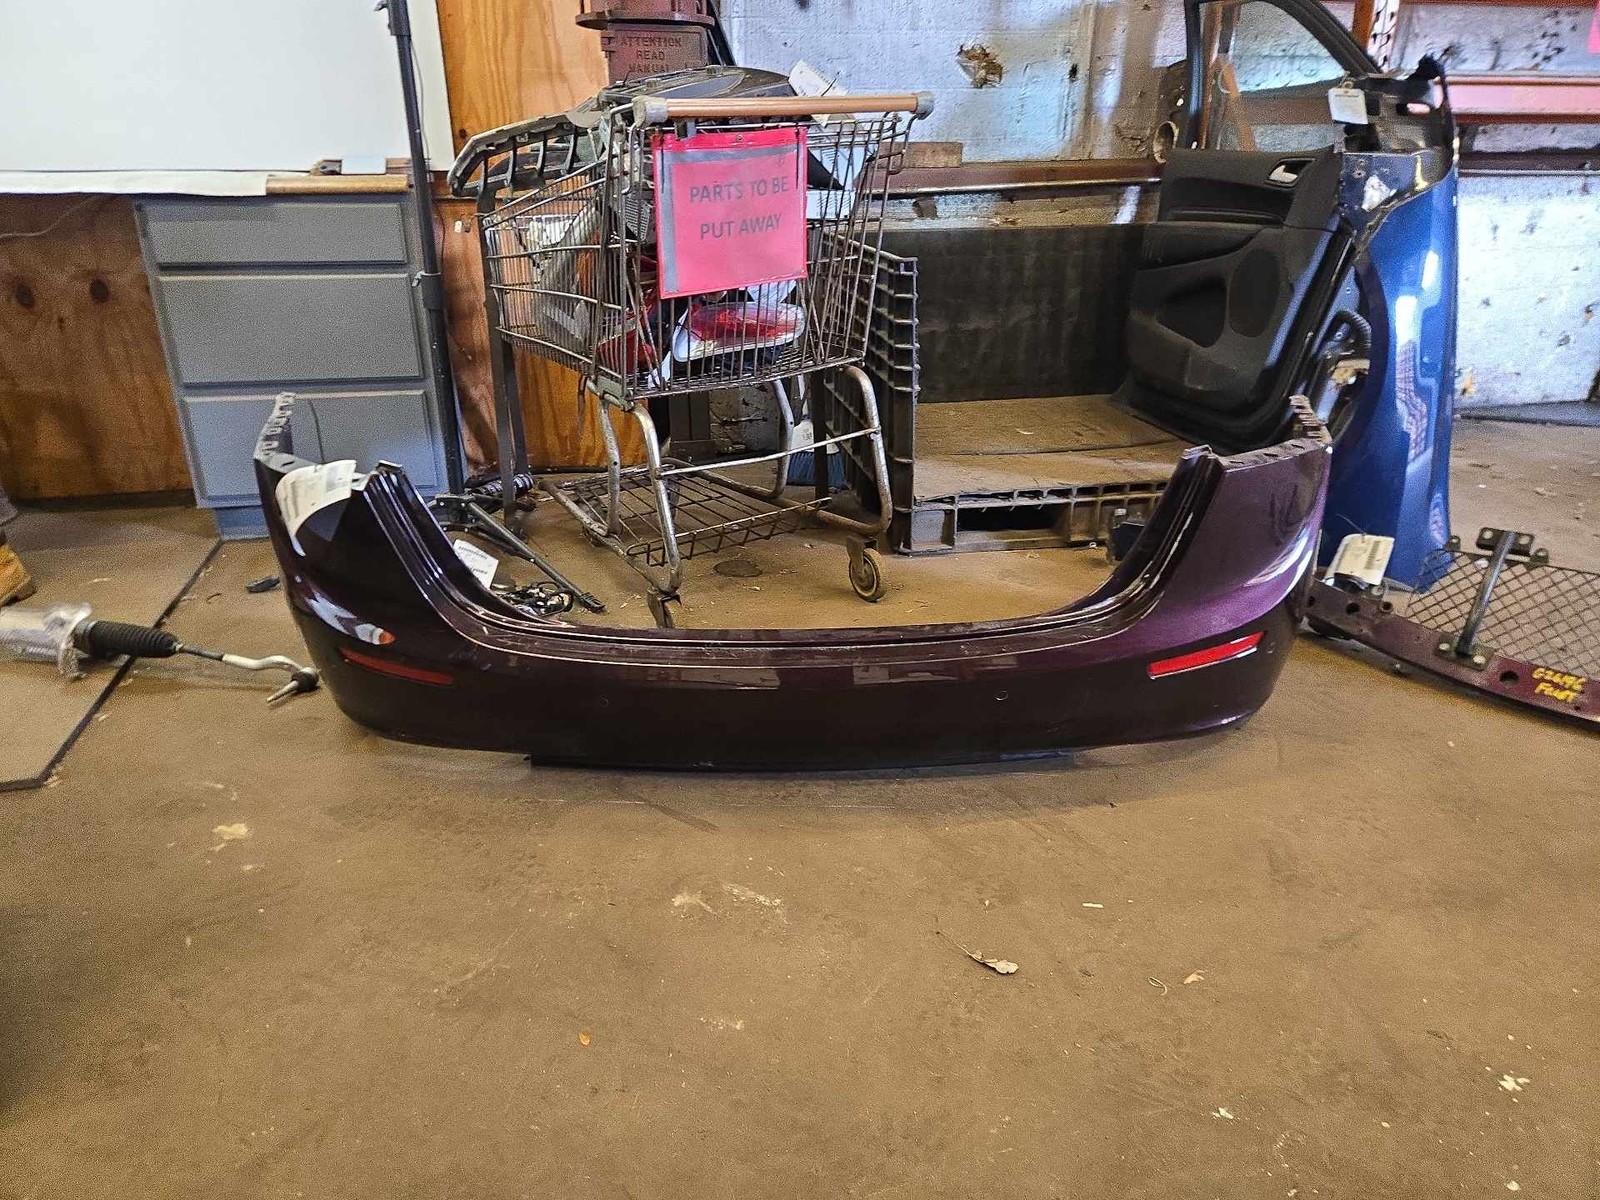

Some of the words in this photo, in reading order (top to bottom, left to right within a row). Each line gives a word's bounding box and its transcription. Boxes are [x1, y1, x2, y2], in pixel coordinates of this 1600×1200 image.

[619, 36, 682, 47] ATTENTION
[636, 50, 666, 61] READ
[689, 183, 744, 202] PARTS
[749, 179, 768, 198] TO
[772, 175, 789, 195] BE
[700, 220, 735, 240] PUT
[738, 212, 782, 236] AWAY
